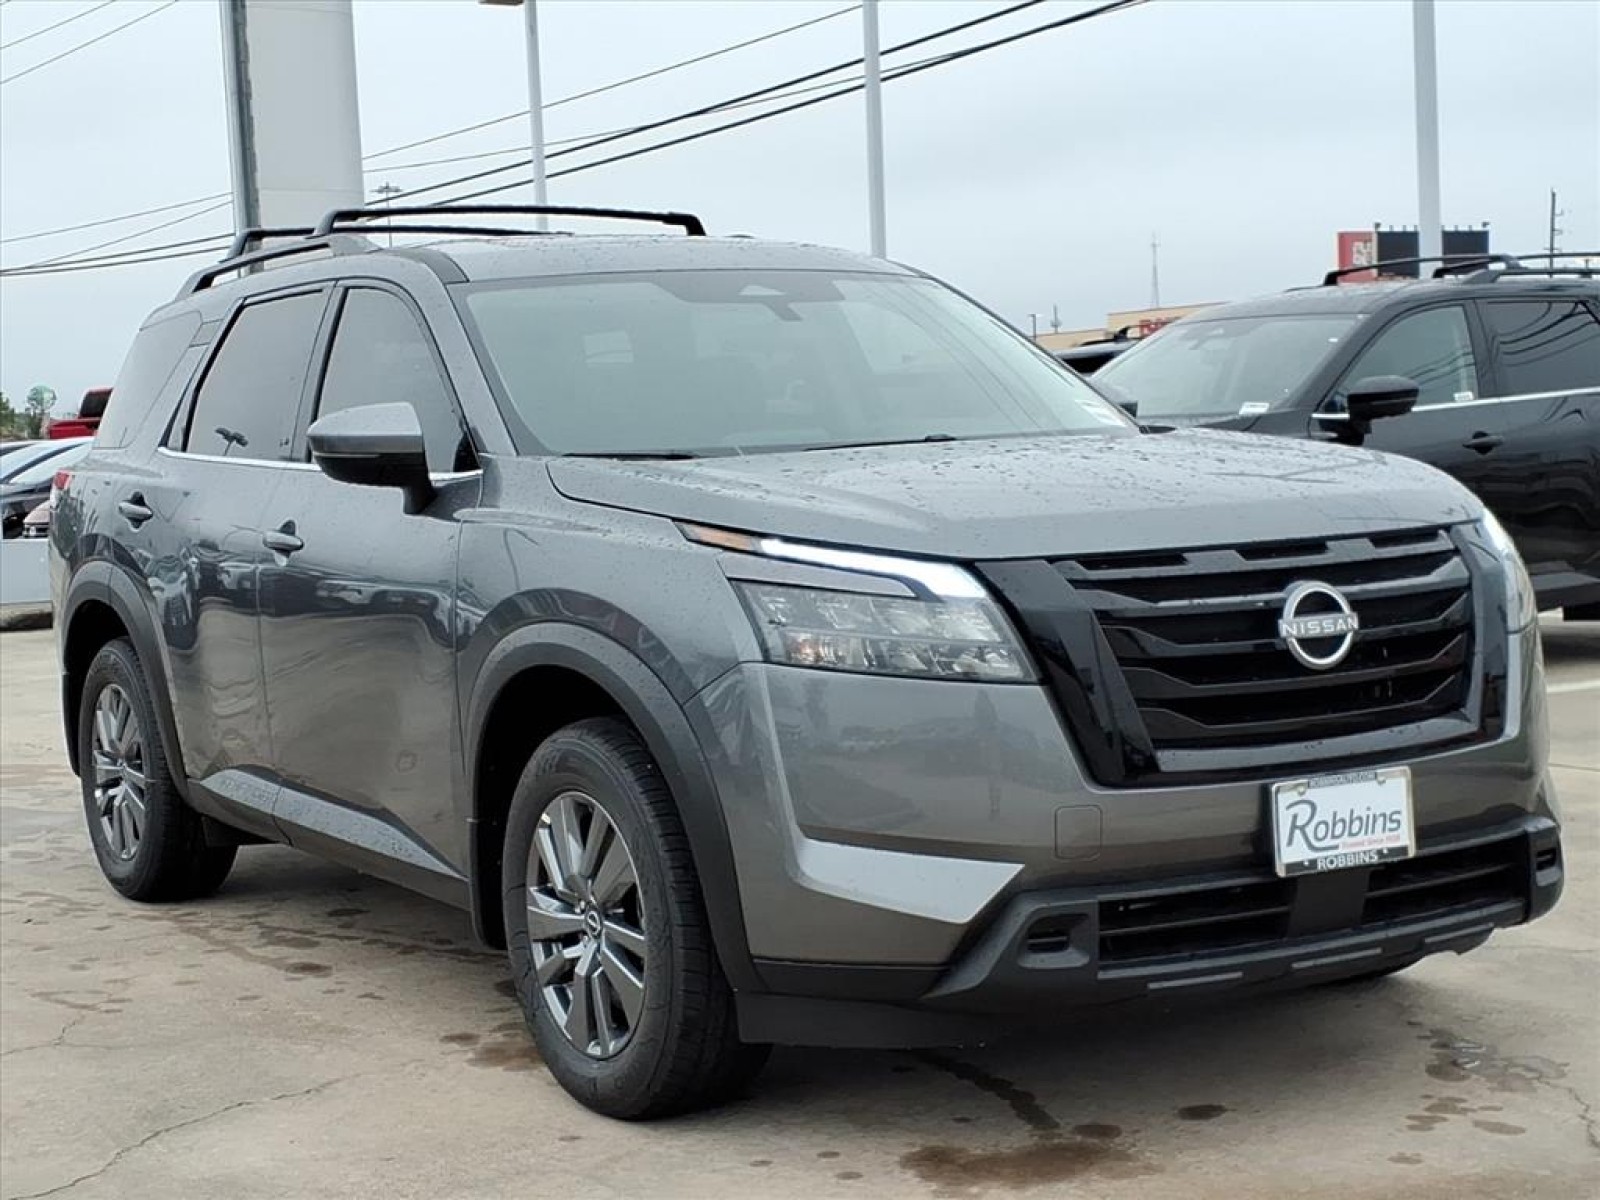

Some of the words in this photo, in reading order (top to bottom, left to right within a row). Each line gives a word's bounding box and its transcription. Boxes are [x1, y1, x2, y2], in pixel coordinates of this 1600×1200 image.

[1281, 616, 1358, 636] NISSAN
[1285, 799, 1402, 852] Robbins
[1316, 851, 1379, 870] ROBBINS
